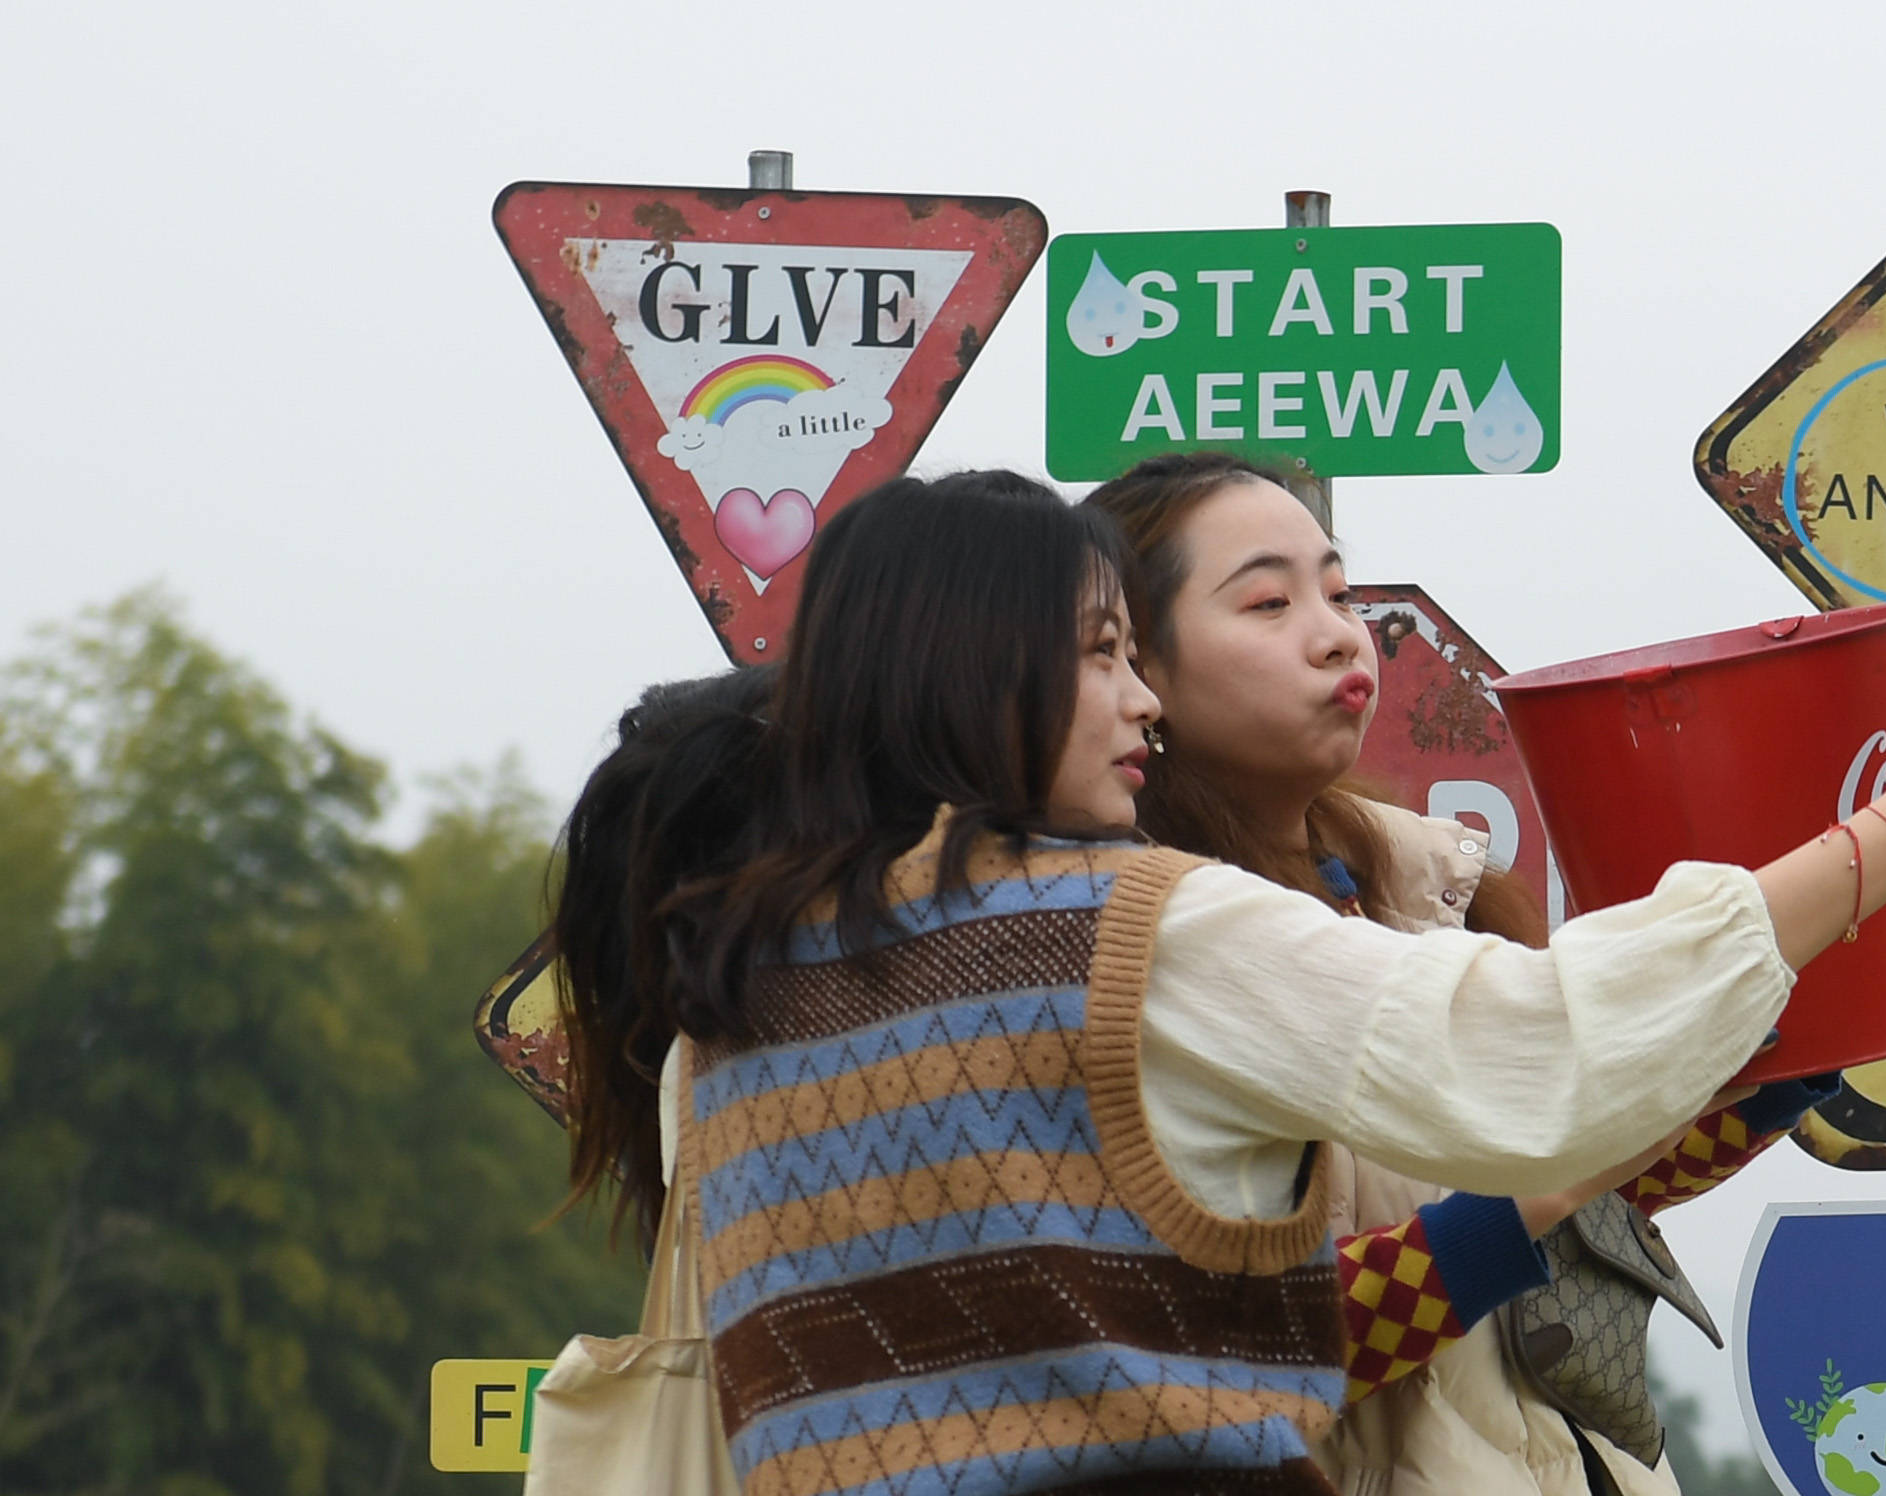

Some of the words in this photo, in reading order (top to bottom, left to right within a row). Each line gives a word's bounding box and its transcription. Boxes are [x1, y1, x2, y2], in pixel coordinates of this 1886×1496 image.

[1125, 264, 1485, 341] START
[777, 423, 792, 438] a
[801, 408, 868, 436] little
[1119, 367, 1477, 443] AEEWA
